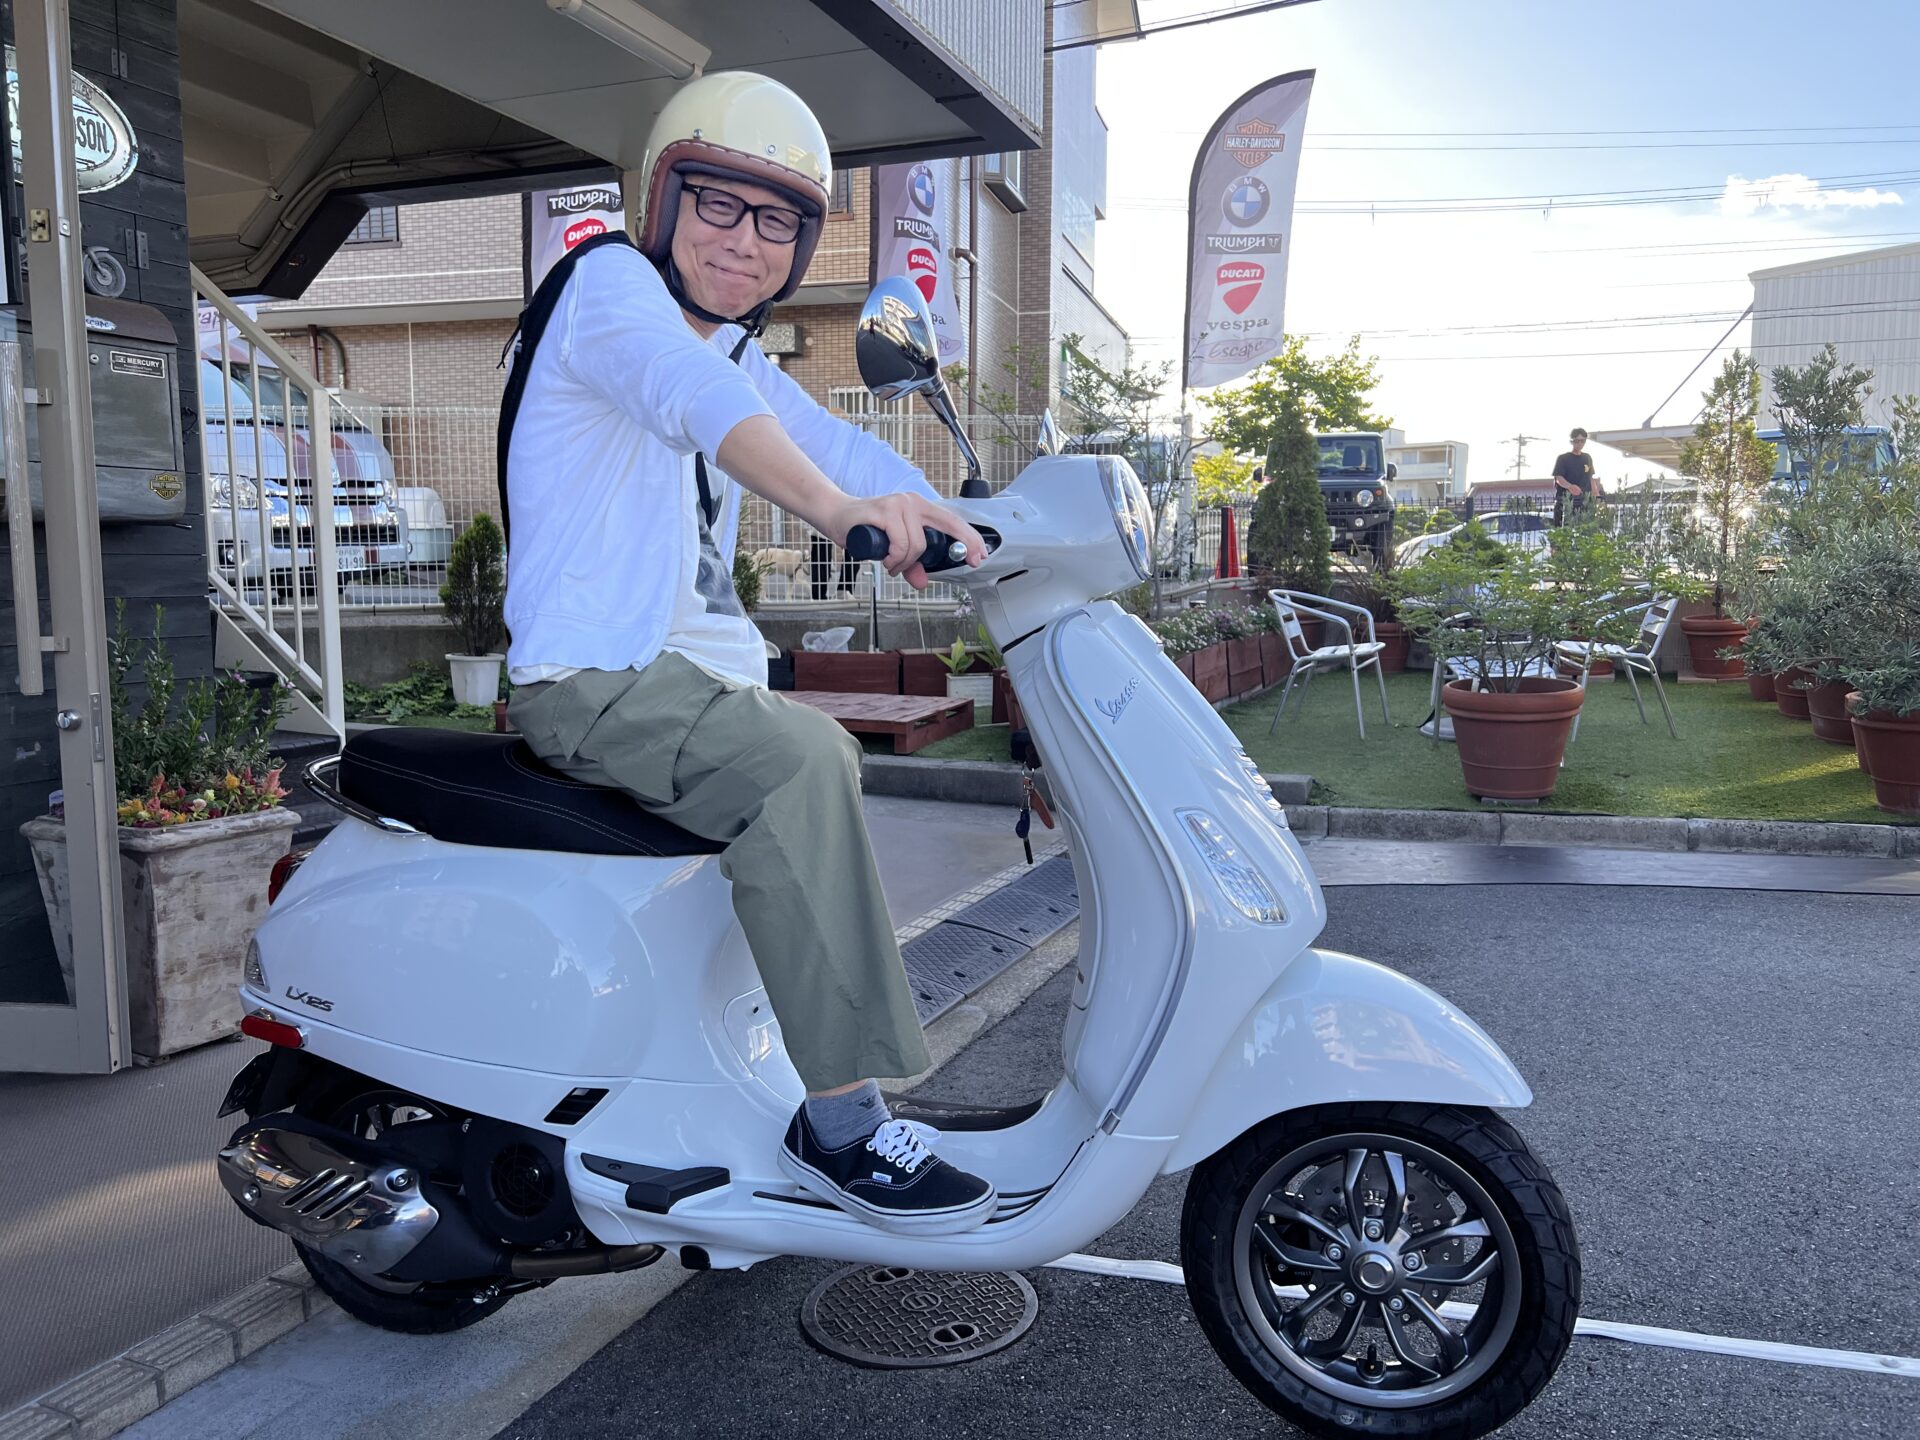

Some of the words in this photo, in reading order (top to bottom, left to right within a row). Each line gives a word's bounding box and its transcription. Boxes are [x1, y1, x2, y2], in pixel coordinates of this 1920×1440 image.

[1240, 122, 1270, 134] MOTOR
[1227, 137, 1280, 149] HARLEY-DAVIDSON
[1237, 151, 1266, 165] CYCLES
[549, 191, 610, 212] TRIUMPH
[1207, 236, 1266, 252] TRIUMPH
[1220, 268, 1261, 278] DUCATI
[930, 312, 947, 325] pa
[1206, 318, 1270, 332] vespa
[127, 357, 160, 368] MERCURY
